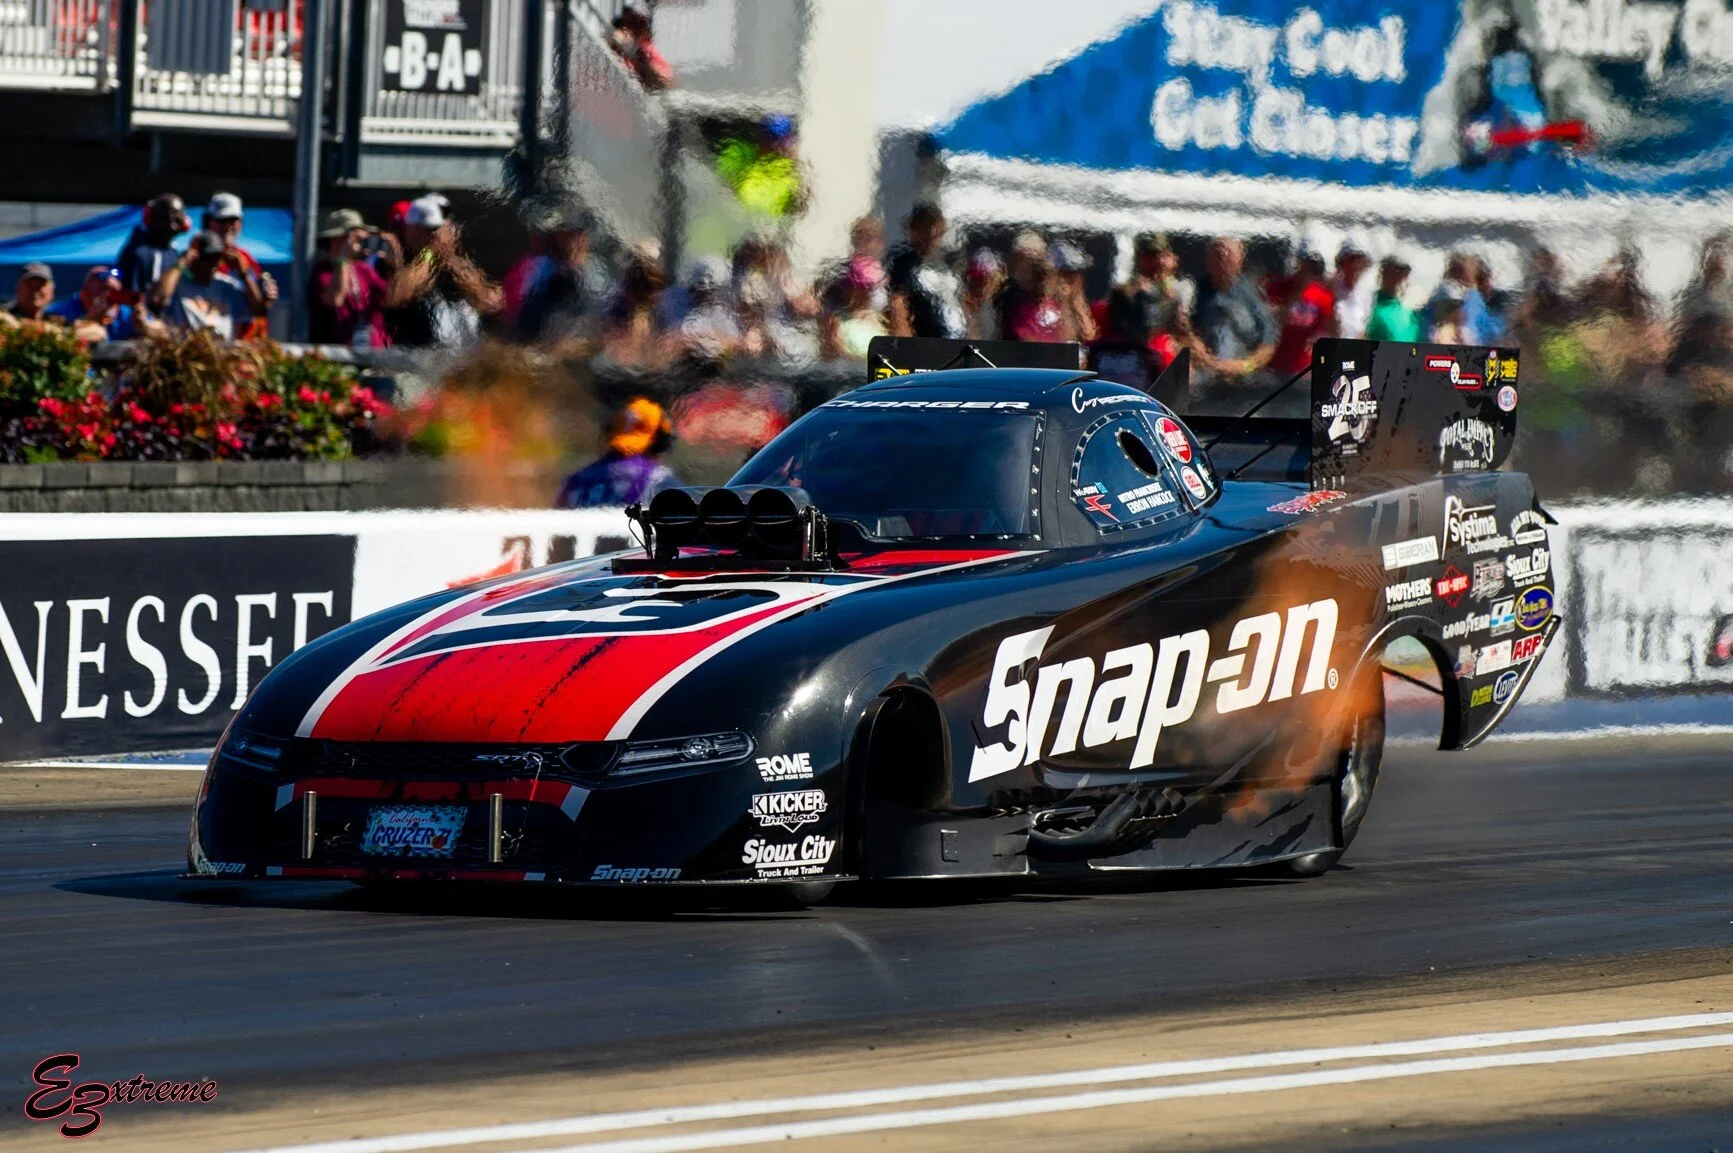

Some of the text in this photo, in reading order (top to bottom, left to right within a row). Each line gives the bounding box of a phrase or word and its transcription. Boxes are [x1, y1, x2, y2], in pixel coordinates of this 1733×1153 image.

[1285, 7, 1408, 84] Cool
[824, 400, 1030, 410] CHARGER
[1321, 400, 1378, 418] SMACKOFF
[1449, 512, 1498, 547] Systima
[1506, 547, 1550, 578] Sioux City
[1385, 577, 1433, 604] MOTHERS
[968, 597, 1339, 784] Snap-on
[755, 752, 814, 777] ROME
[768, 791, 824, 814] KICKER
[372, 826, 434, 845] CRUZER
[742, 835, 836, 864] Sioux City
[590, 864, 682, 882] Snap-on
[757, 865, 825, 878] Truck And Trailer
